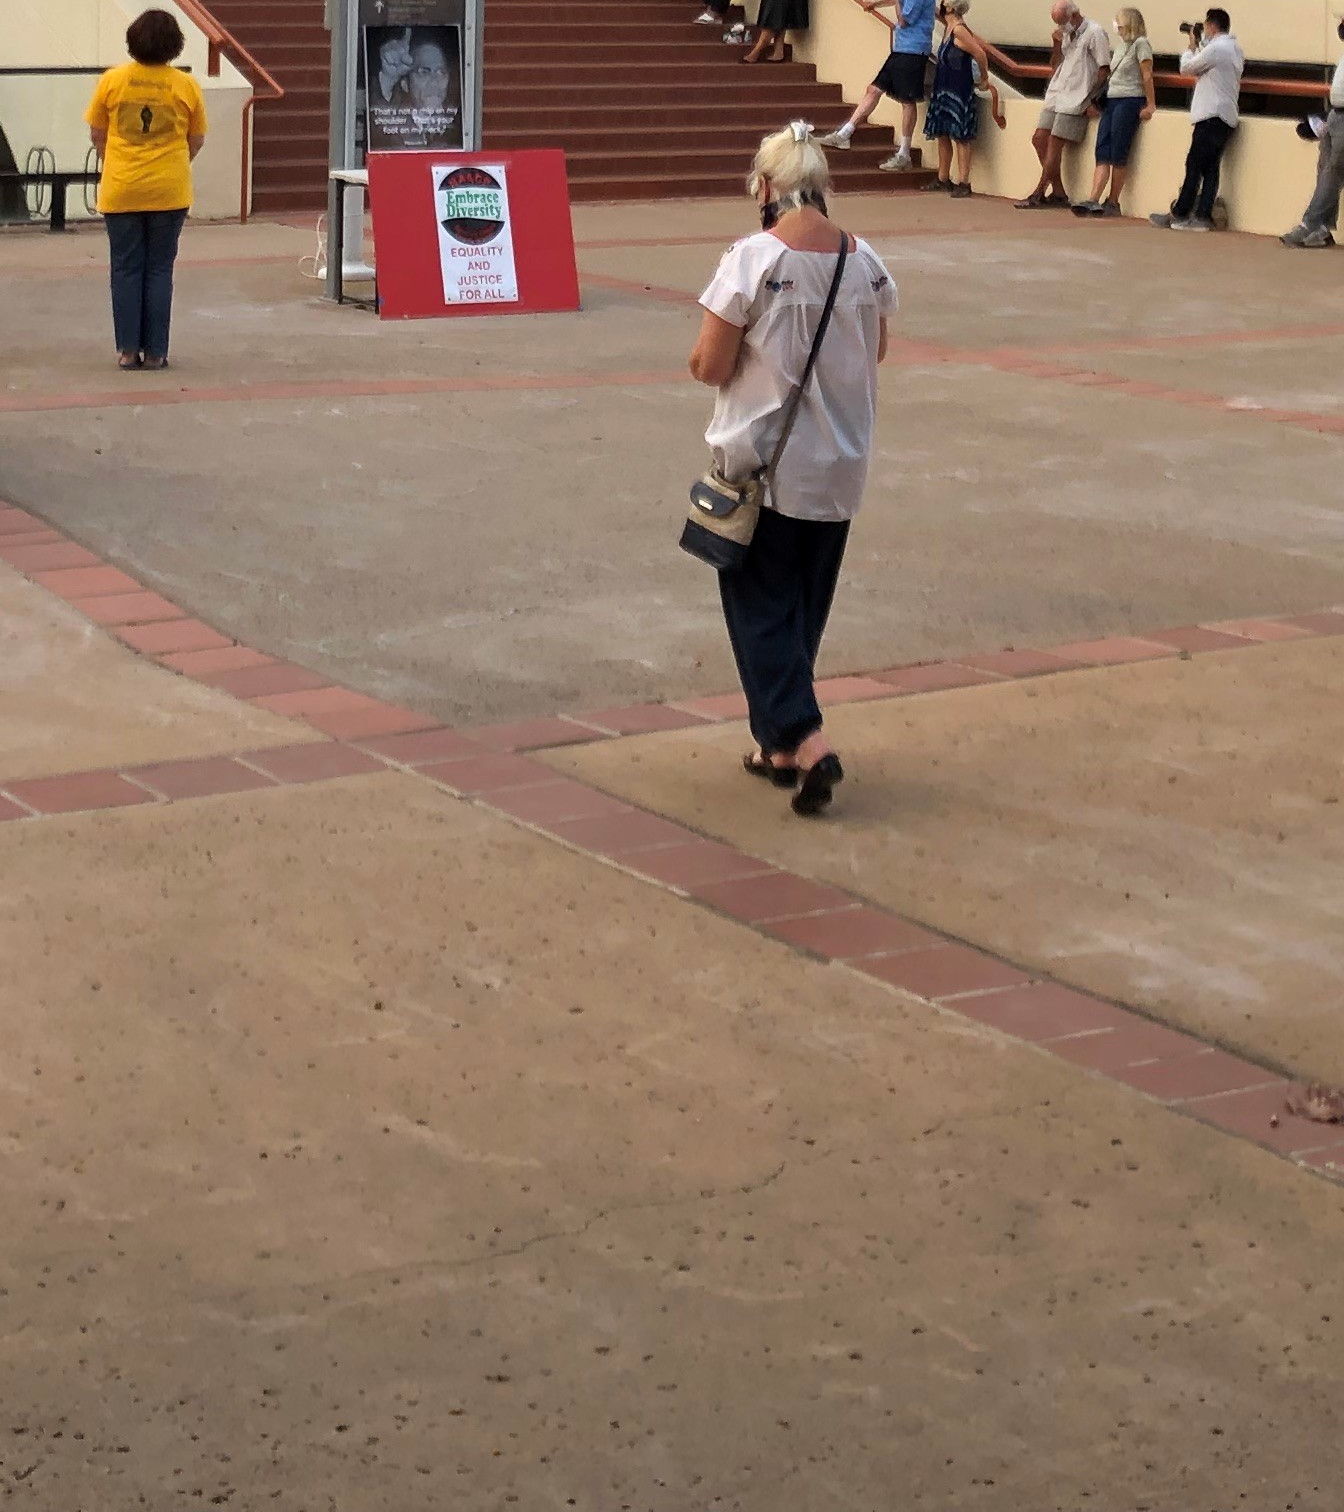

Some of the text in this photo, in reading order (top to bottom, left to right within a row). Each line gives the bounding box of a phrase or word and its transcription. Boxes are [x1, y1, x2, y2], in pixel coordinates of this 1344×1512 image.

[446, 190, 499, 204] Embrace
[446, 203, 502, 219] Diversity
[450, 246, 503, 257] EQUALITY
[467, 261, 491, 271] AND
[457, 274, 503, 286] JUSTICE
[459, 288, 505, 300] FOR ALL
